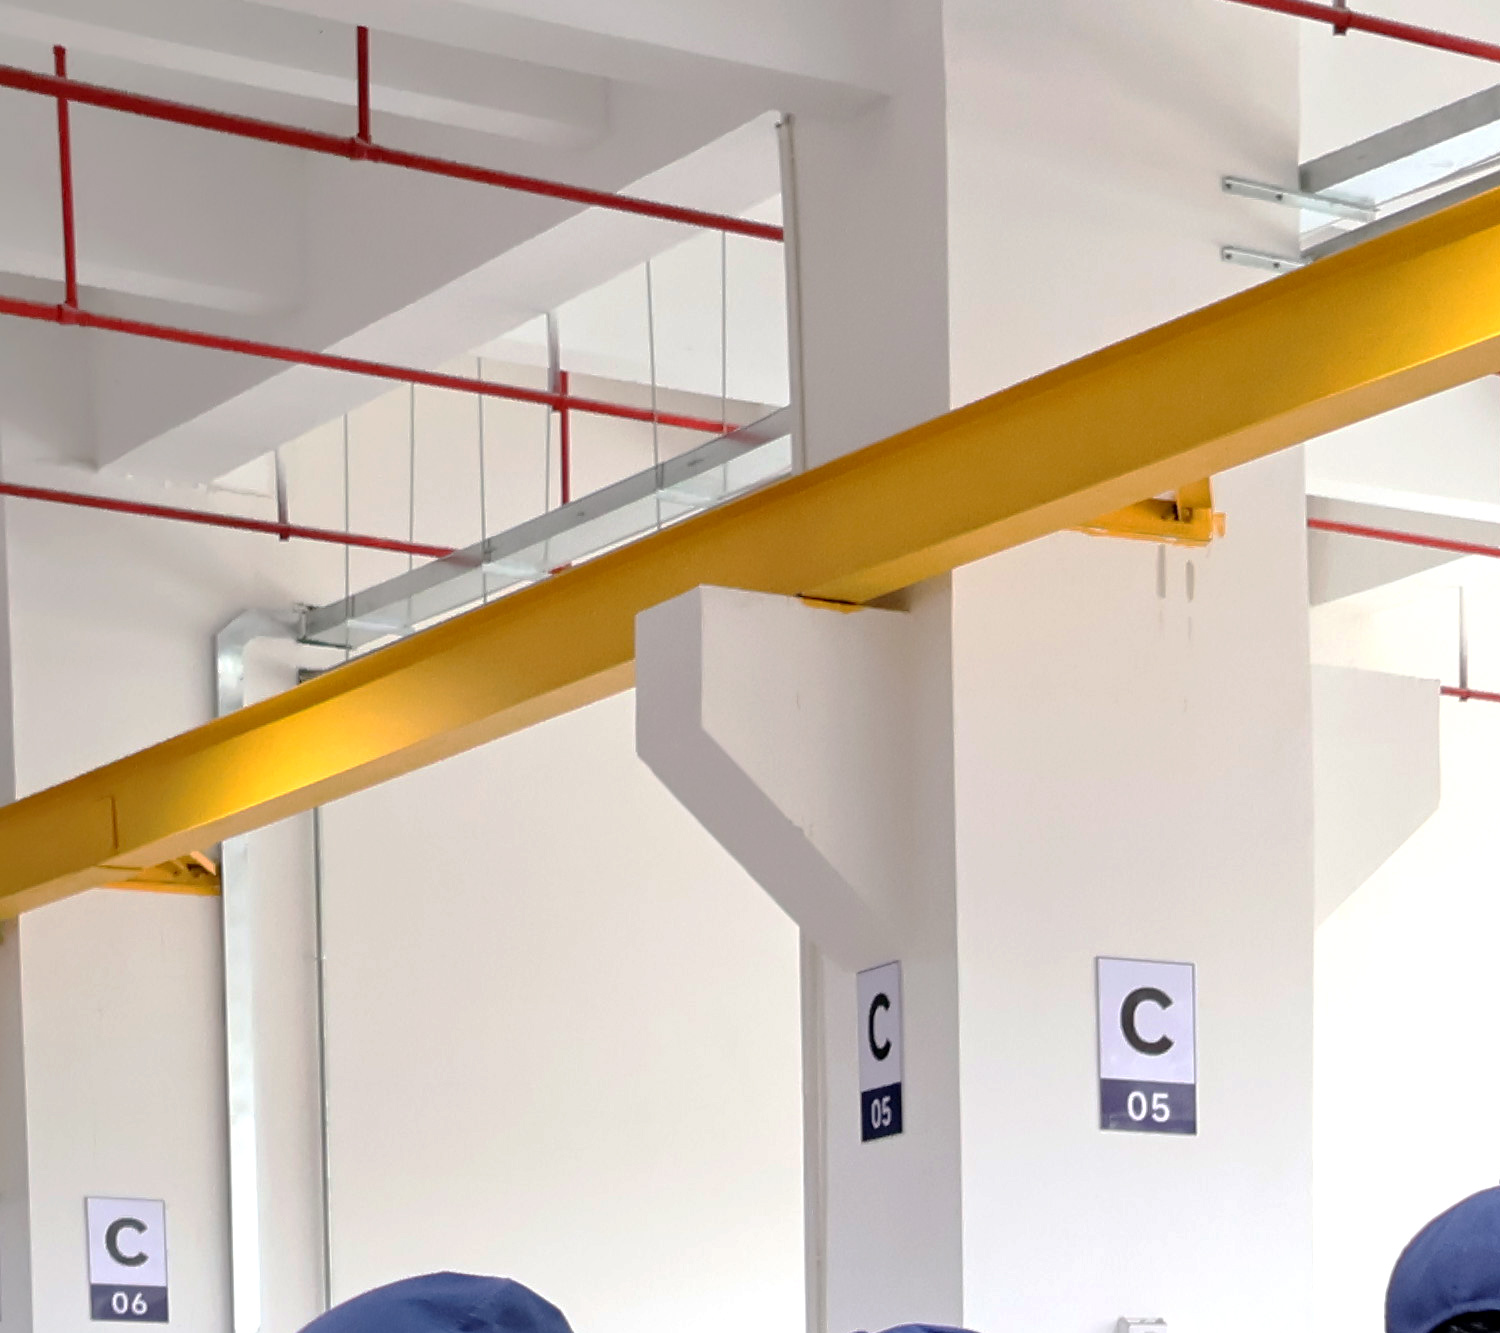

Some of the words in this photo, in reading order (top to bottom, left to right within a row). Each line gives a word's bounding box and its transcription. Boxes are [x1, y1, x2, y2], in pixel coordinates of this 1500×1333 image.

[868, 992, 892, 1062] C
[1120, 987, 1174, 1056] C
[870, 1096, 892, 1130] 05
[1127, 1090, 1171, 1124] 05
[105, 1218, 148, 1267] C
[111, 1291, 148, 1316] 06
